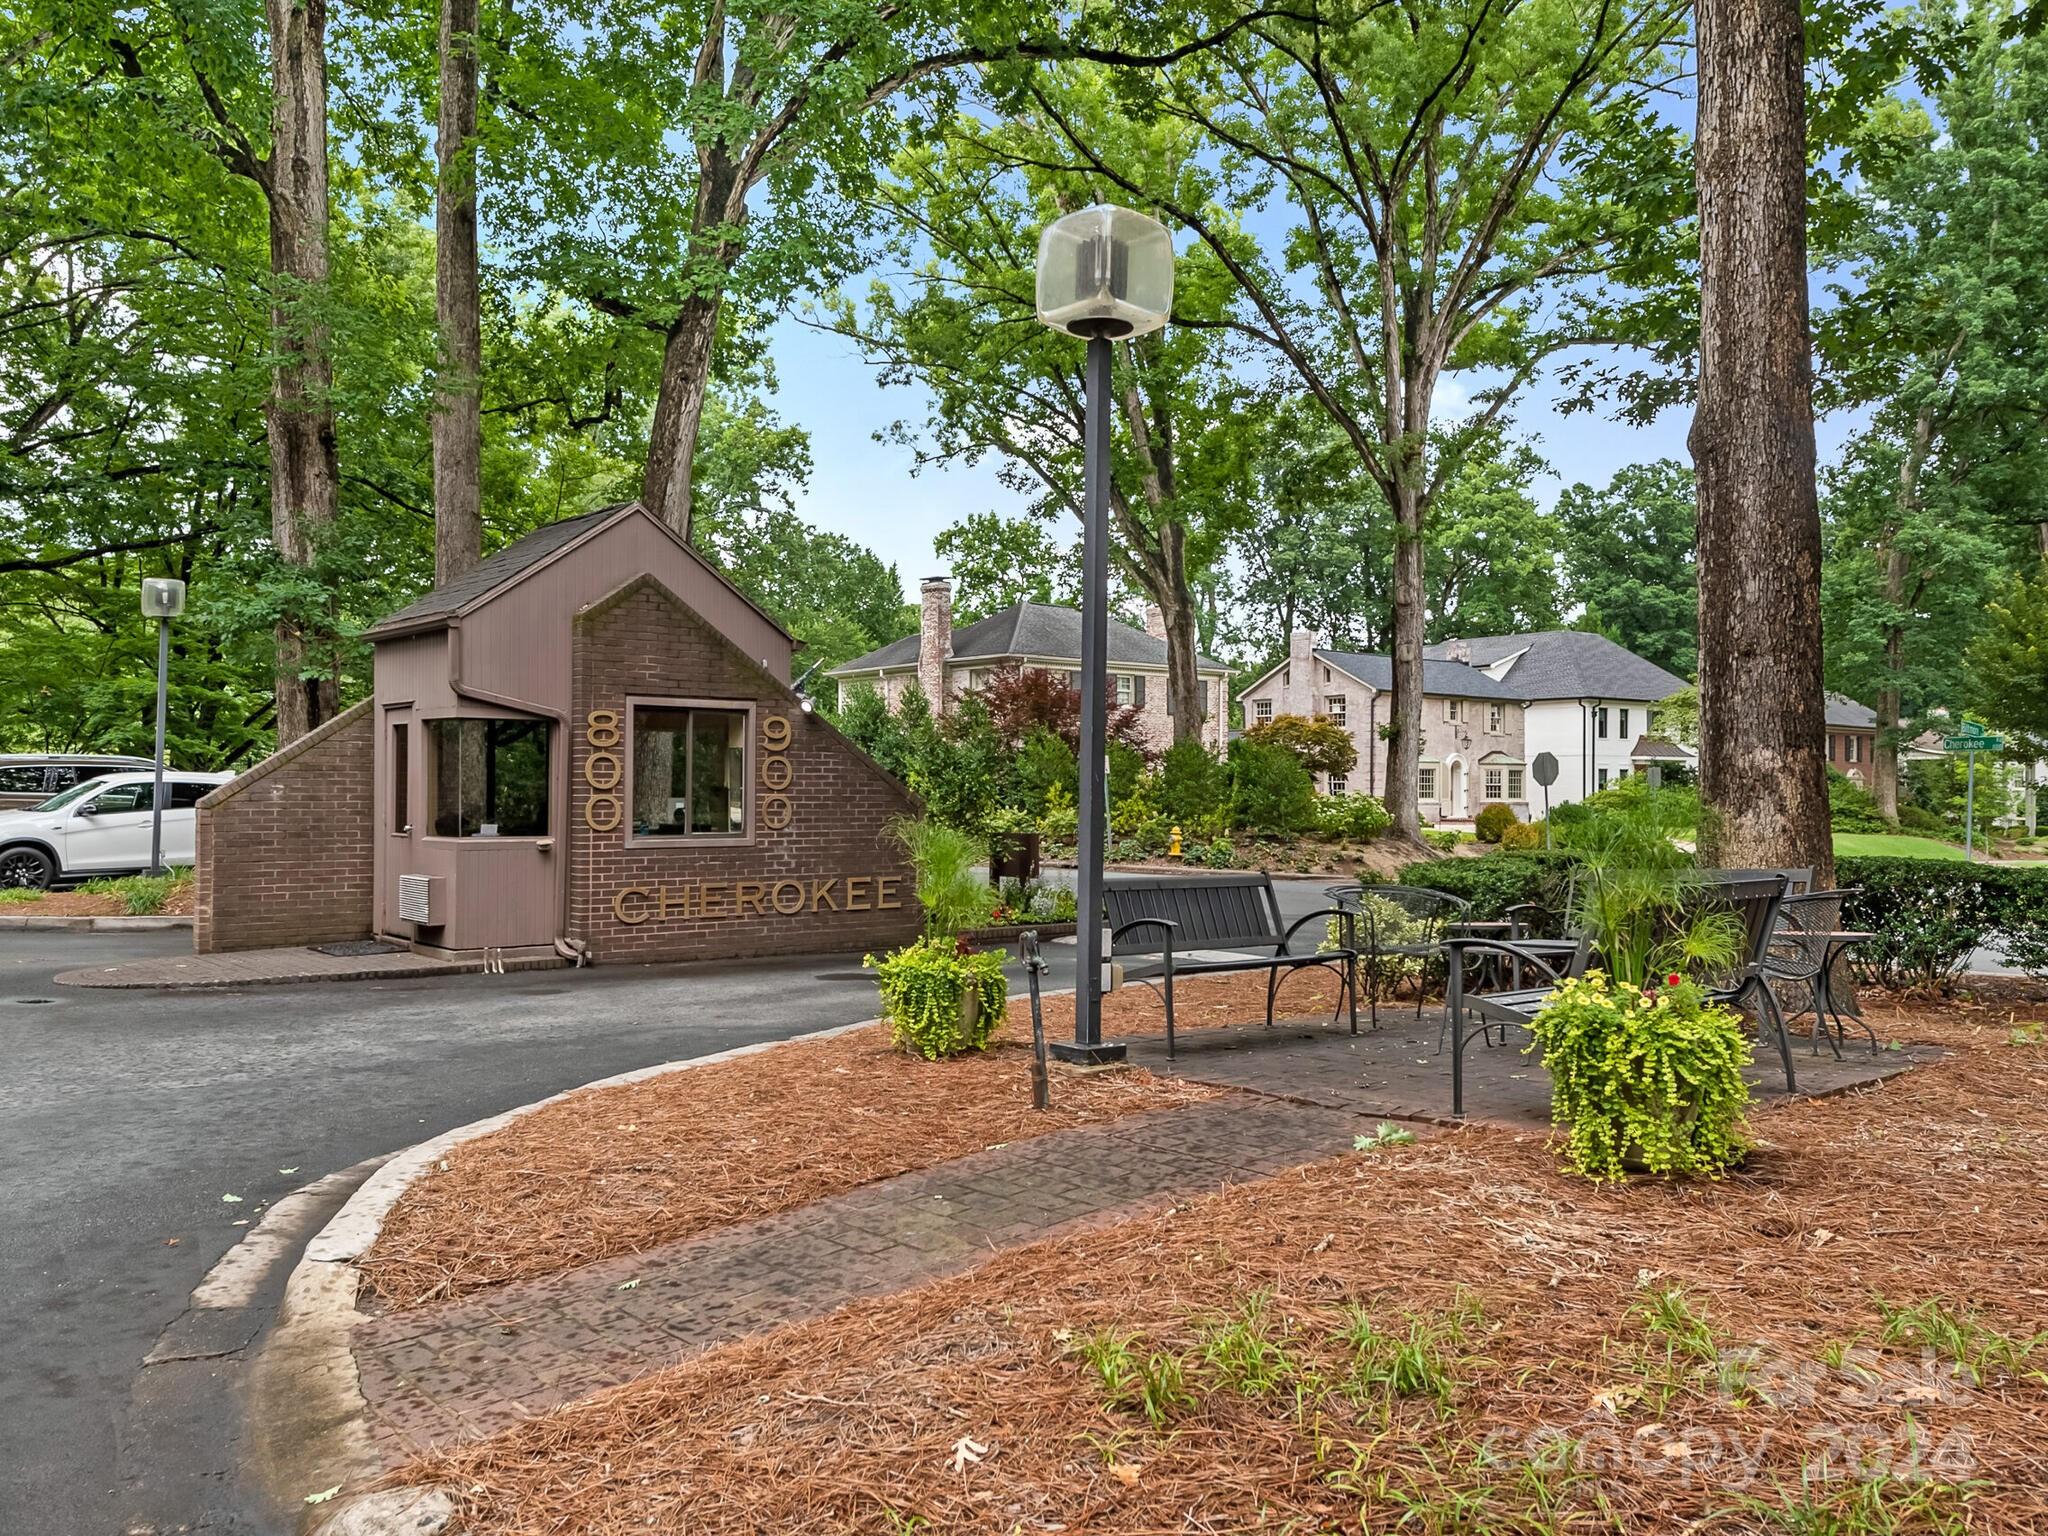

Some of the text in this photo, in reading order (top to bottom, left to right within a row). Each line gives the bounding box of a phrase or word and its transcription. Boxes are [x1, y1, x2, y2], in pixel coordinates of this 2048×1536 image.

[585, 710, 622, 831] 800
[762, 716, 793, 829] 900
[1944, 739, 1985, 749] Cherokee
[614, 876, 902, 924] CHEROKEE
